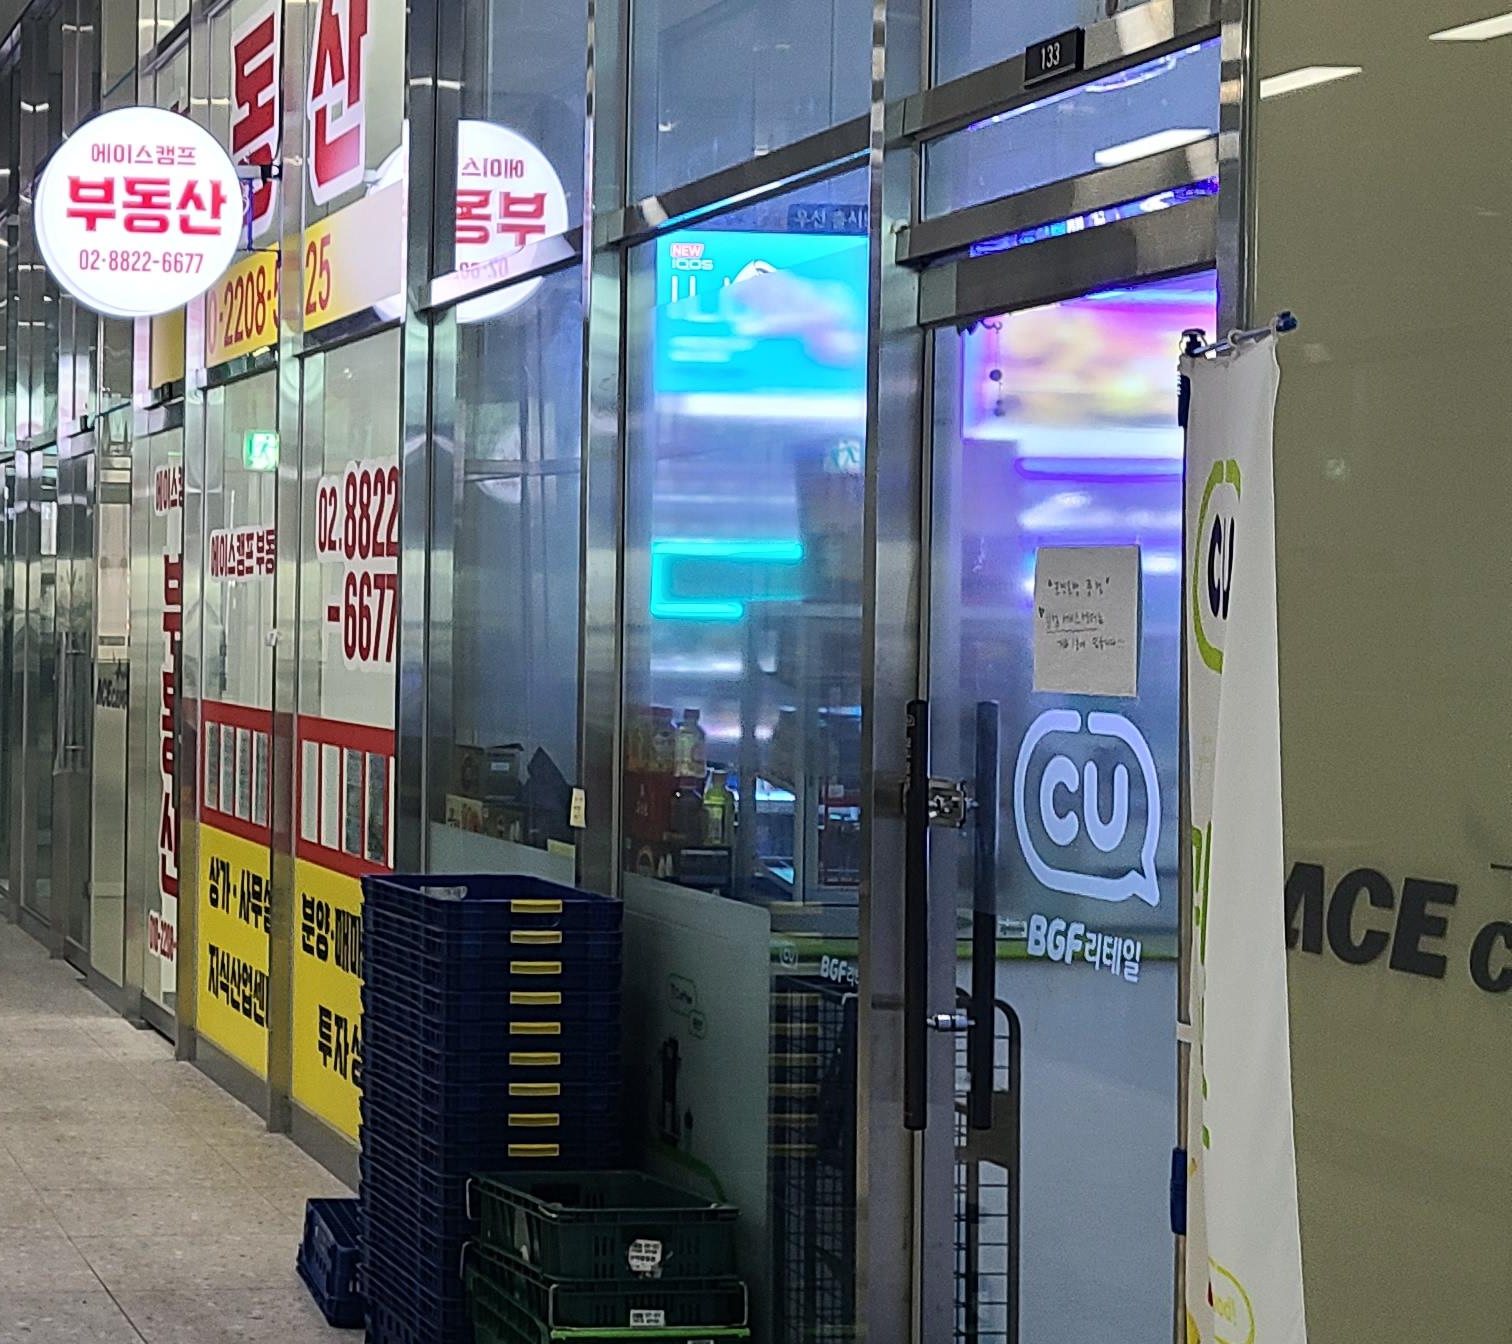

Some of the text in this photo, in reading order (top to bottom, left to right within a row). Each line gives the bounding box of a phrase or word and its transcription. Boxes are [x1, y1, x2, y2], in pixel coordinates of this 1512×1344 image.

[1041, 42, 1060, 70] 133
[91, 142, 197, 165] 에이스캠프
[66, 175, 227, 236] 부동산
[672, 245, 700, 257] NEW
[210, 532, 255, 578] 에이스캠프
[1208, 512, 1235, 621] CU
[1040, 755, 1129, 853] CU
[1027, 914, 1143, 983] BGF리테일
